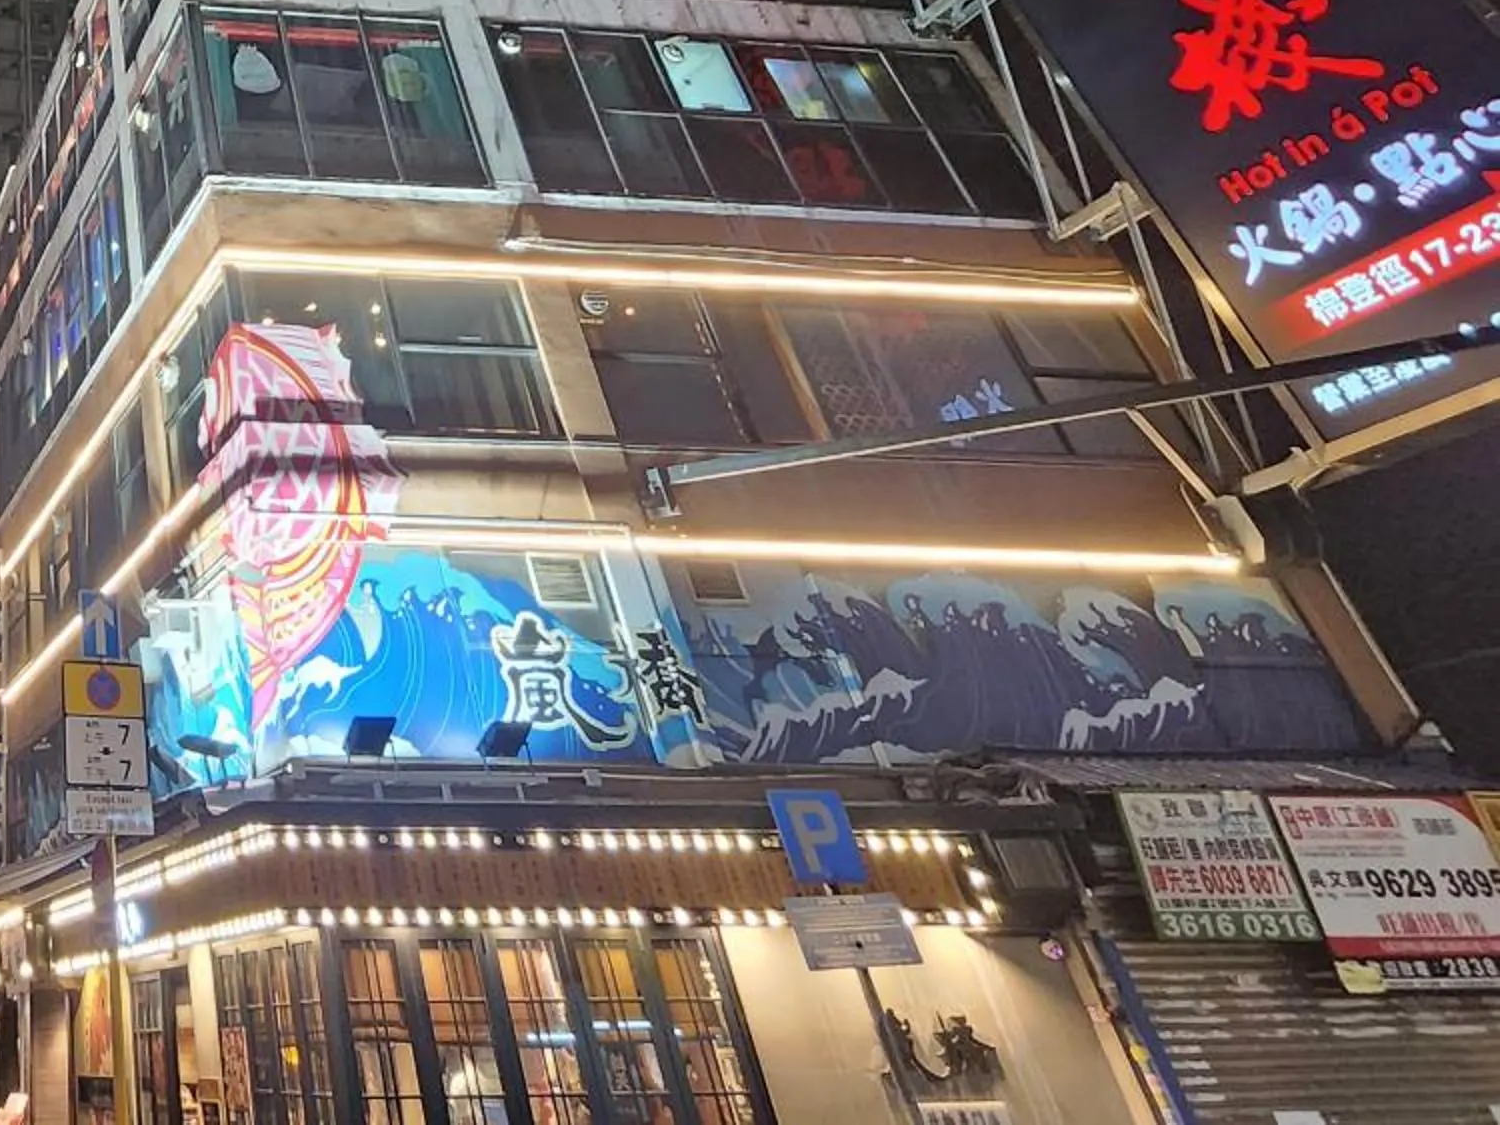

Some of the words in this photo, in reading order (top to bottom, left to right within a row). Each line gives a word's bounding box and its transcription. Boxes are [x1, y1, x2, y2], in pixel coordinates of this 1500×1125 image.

[1219, 151, 1287, 204] Hot
[1283, 134, 1330, 166] in
[1361, 66, 1439, 122] Pot
[117, 724, 132, 745] 7
[119, 759, 132, 781] 7
[786, 800, 838, 873] P
[1364, 868, 1437, 898] 9629
[1160, 913, 1237, 938] 3616
[1242, 913, 1315, 939] 0316
